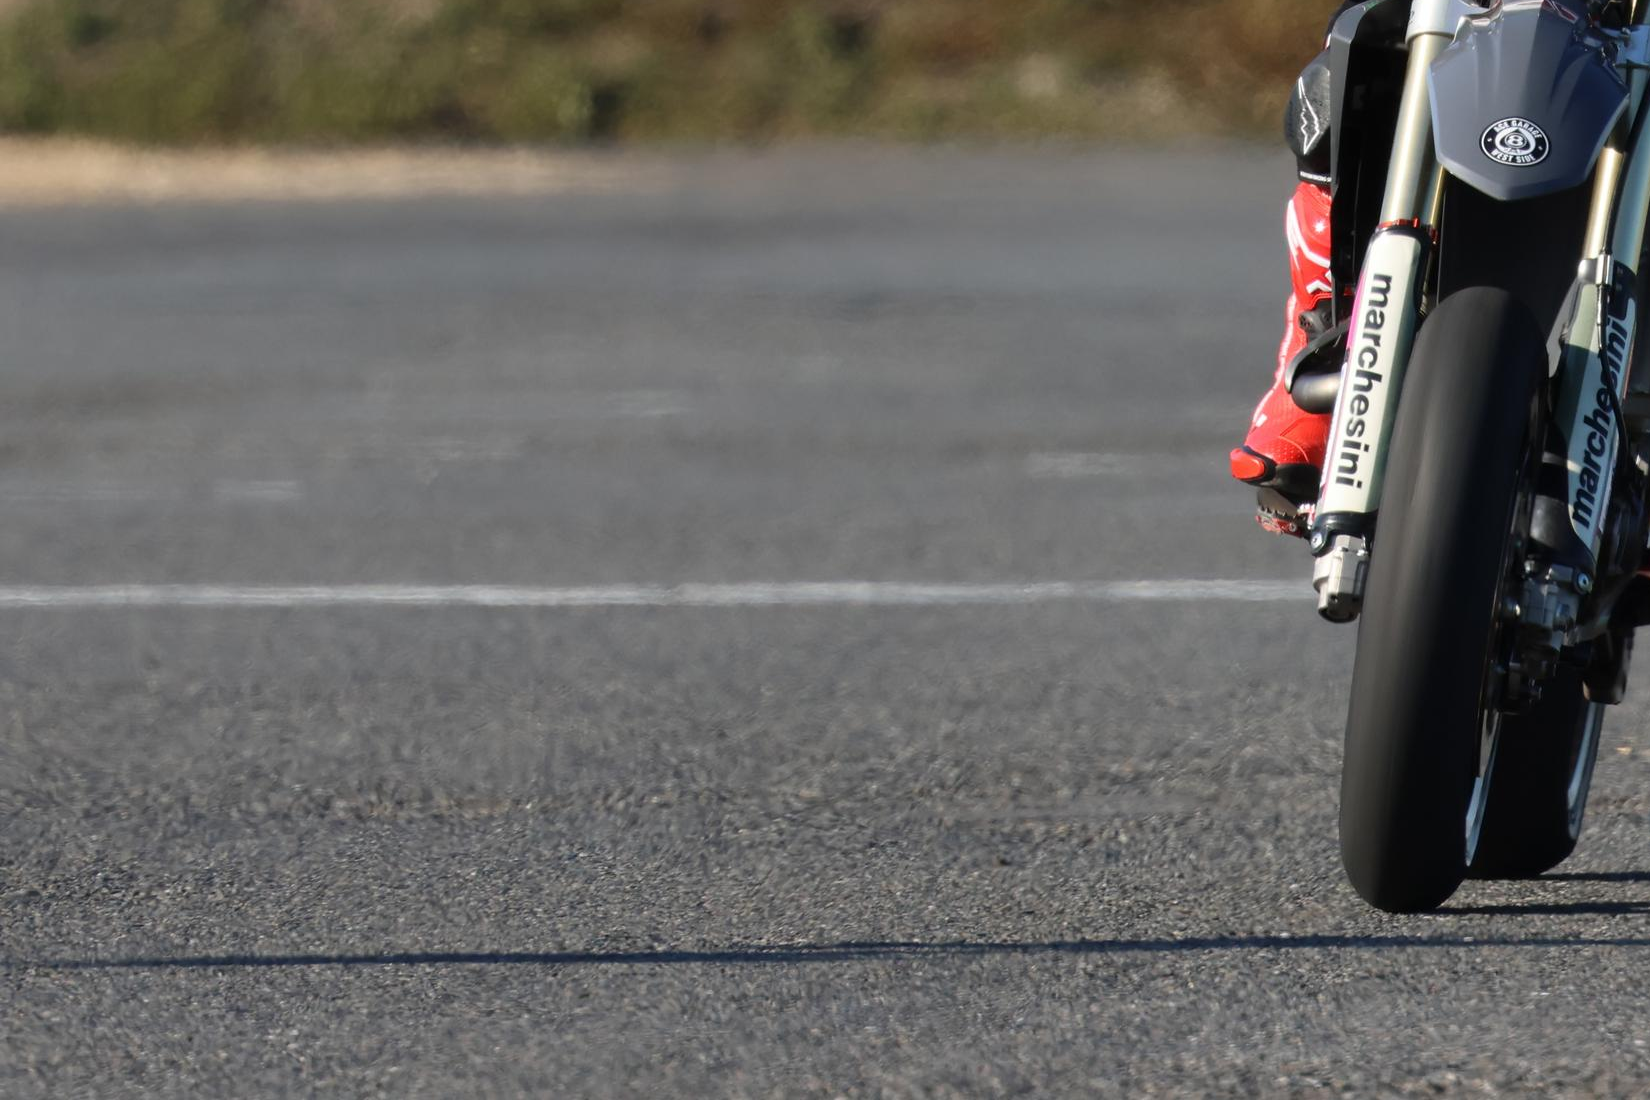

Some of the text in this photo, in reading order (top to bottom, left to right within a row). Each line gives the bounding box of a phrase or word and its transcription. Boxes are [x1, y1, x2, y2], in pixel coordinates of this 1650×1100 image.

[1491, 149, 1535, 162] WEST SIDE
[1335, 273, 1393, 489] marchesini
